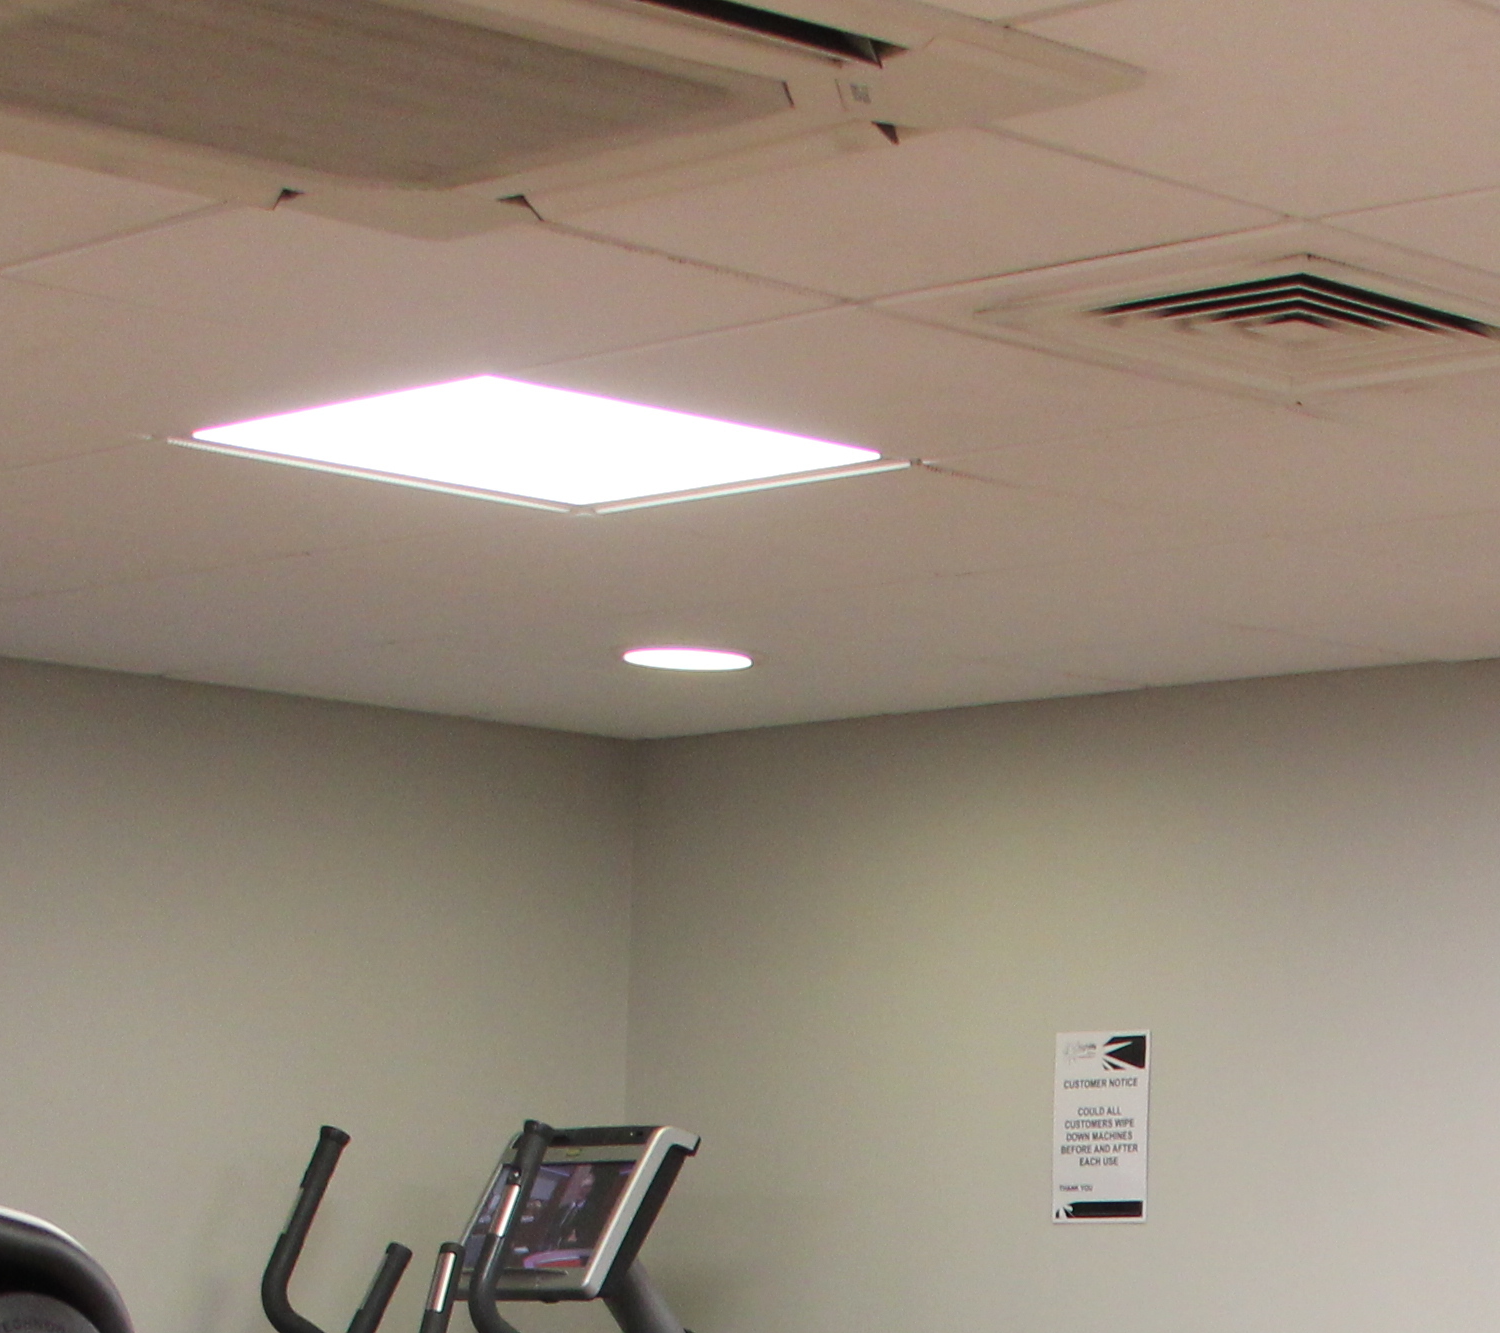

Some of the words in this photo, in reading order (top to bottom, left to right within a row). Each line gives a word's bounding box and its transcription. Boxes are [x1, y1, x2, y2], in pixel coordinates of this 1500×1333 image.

[1064, 1079, 1107, 1089] CUSTOMER
[1109, 1078, 1138, 1088] NOTICE
[1078, 1107, 1104, 1116] COULD
[1106, 1106, 1121, 1115] ALL
[1064, 1119, 1112, 1129] CUSTOMERS
[1115, 1118, 1134, 1128] WIPE
[1066, 1132, 1090, 1142] DOWN
[1092, 1131, 1133, 1141] MACHINES
[1061, 1145, 1092, 1154] BEFORE
[1094, 1144, 1111, 1153] AND
[1112, 1143, 1138, 1153] AFTER
[1079, 1157, 1100, 1166] EACH
[1102, 1157, 1118, 1166] USE
